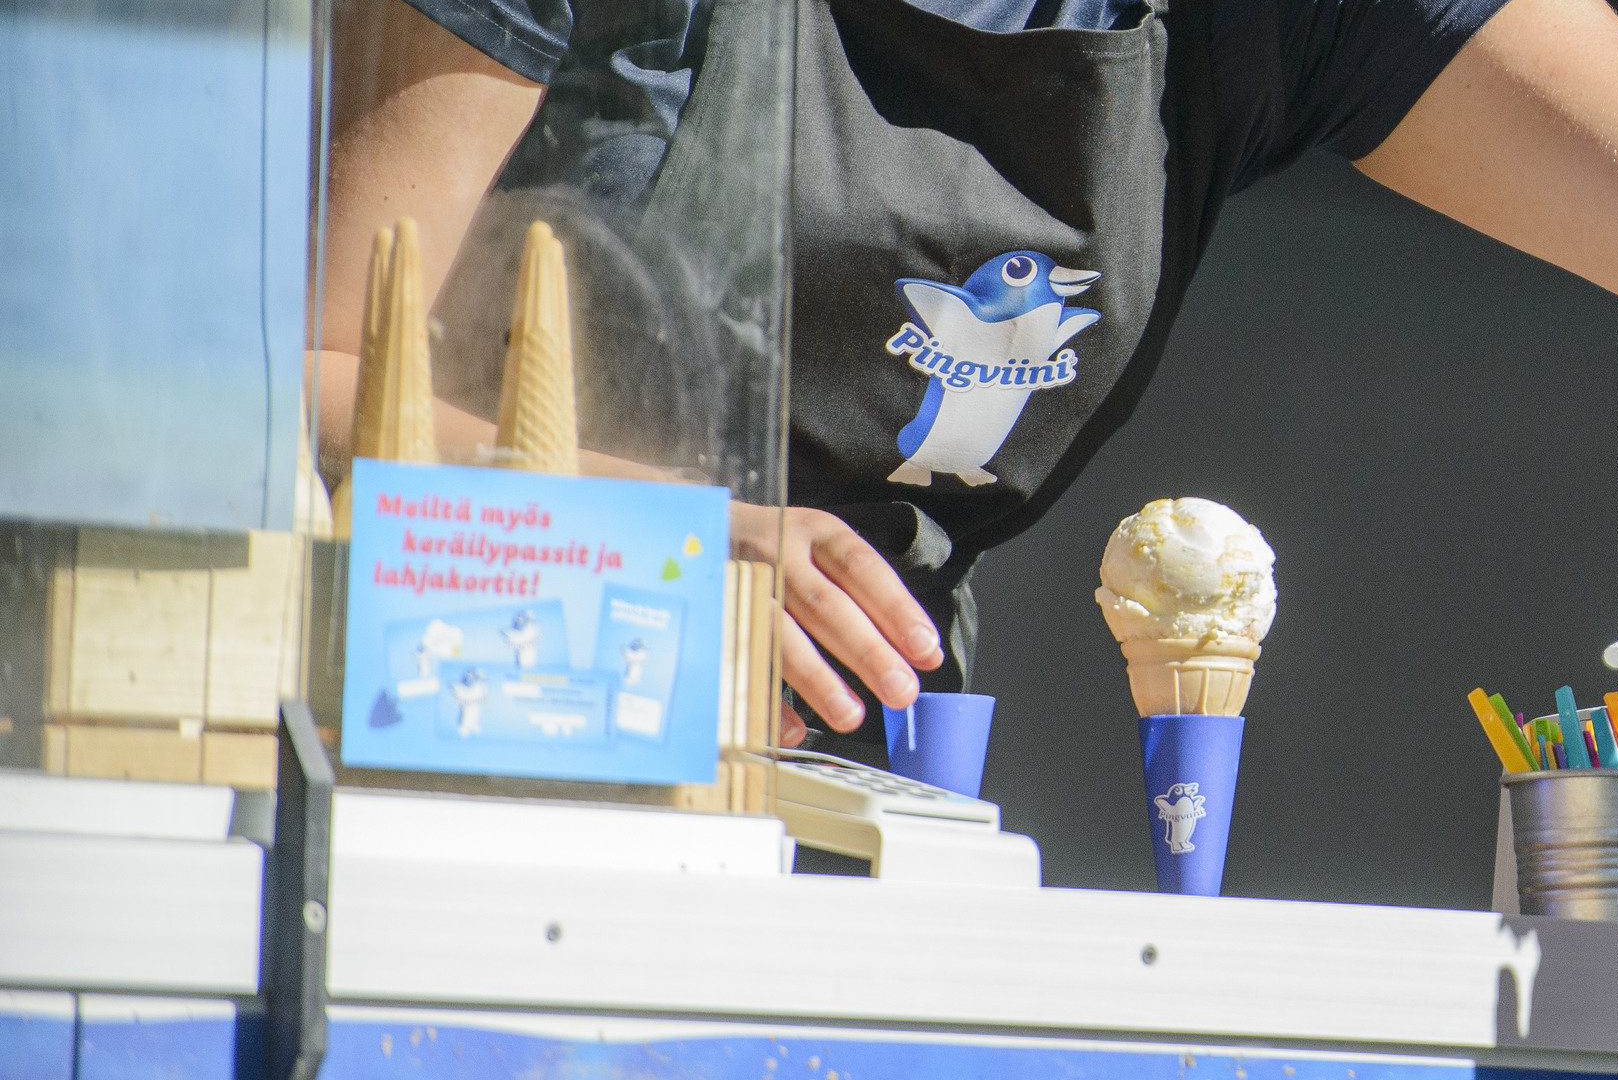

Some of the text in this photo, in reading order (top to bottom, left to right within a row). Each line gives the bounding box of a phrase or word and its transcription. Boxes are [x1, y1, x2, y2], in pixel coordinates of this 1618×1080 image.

[890, 324, 1072, 390] Pingviini
[376, 493, 553, 532] Meiltä myös
[402, 527, 623, 575] keräilypassit ja
[373, 561, 541, 597] lahjakortit!
